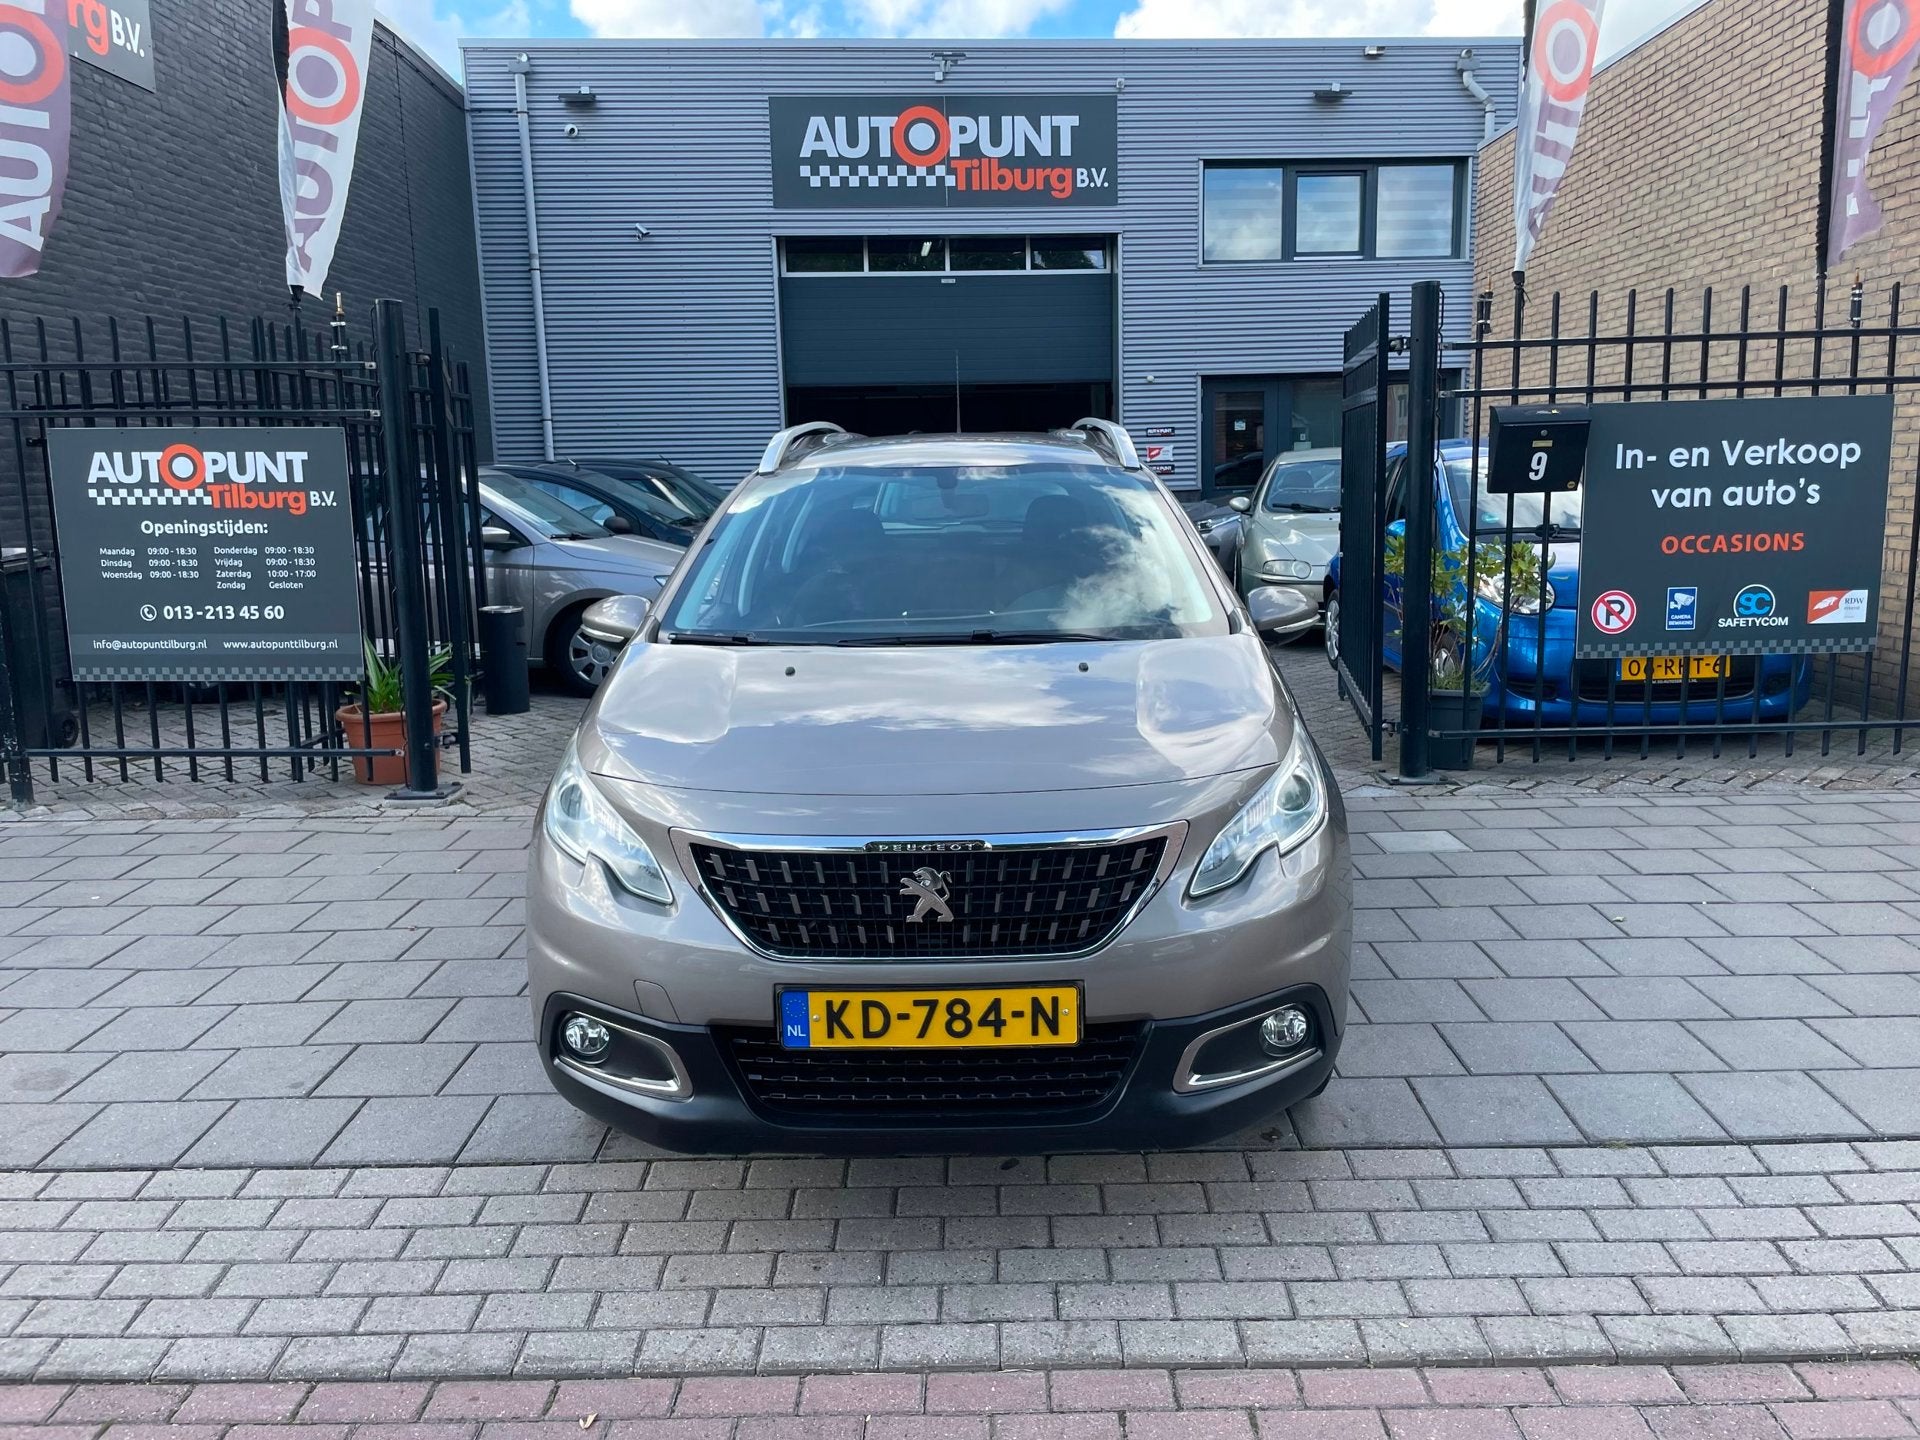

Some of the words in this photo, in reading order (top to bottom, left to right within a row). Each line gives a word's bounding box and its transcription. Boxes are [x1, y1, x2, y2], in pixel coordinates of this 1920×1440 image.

[110, 9, 145, 58] B.V.
[799, 105, 1080, 167] AUTOPUNT
[951, 158, 1073, 199] Tilburg
[1076, 167, 1109, 188] B.V.
[1615, 443, 1657, 469] In-
[1669, 446, 1710, 468] en
[1721, 438, 1861, 469] Verkoop
[87, 443, 309, 490] AUTOPUNT
[1529, 452, 1548, 481] 9
[207, 483, 307, 516] Tilburg
[310, 491, 337, 507] B.V.
[1651, 486, 1712, 508] van
[1722, 478, 1821, 507] auto's
[140, 519, 269, 537] Openingstijden:
[99, 547, 135, 557] Maandag
[147, 547, 169, 555] 09:00
[176, 547, 197, 555] 18:30
[213, 546, 258, 556] Donderdag
[264, 546, 287, 554] 09:00
[293, 546, 315, 554] 18:30
[1661, 532, 1805, 555] OCCASIONS
[100, 559, 132, 568] Dinsdag
[148, 559, 171, 567] 09:00
[177, 559, 198, 567] 18:30
[214, 558, 243, 567] Vrijdag
[265, 558, 288, 566] 09:00
[294, 558, 316, 566] 18:30
[101, 571, 143, 580] Woensdag
[149, 571, 172, 579] 09:00
[178, 571, 199, 579] 18:30
[215, 569, 251, 579] Zaterdag
[267, 570, 289, 578] 10:00
[295, 570, 317, 578] 17:00
[216, 581, 246, 590] Zondag
[268, 581, 304, 589] Gesloten
[1738, 592, 1771, 615] SC
[1844, 597, 1865, 605] RDW
[239, 604, 260, 620] 45
[263, 604, 285, 620] 60
[1718, 616, 1789, 628] SAFETYCOM
[93, 639, 207, 650] info@autopunttilburg.nl
[223, 639, 338, 650] www.autopunttilburg.nl
[1628, 655, 1721, 677] 0-RT-6
[879, 843, 976, 852] PEUGEOT
[825, 995, 1060, 1040] KD-784-N
[787, 1024, 806, 1037] NL
